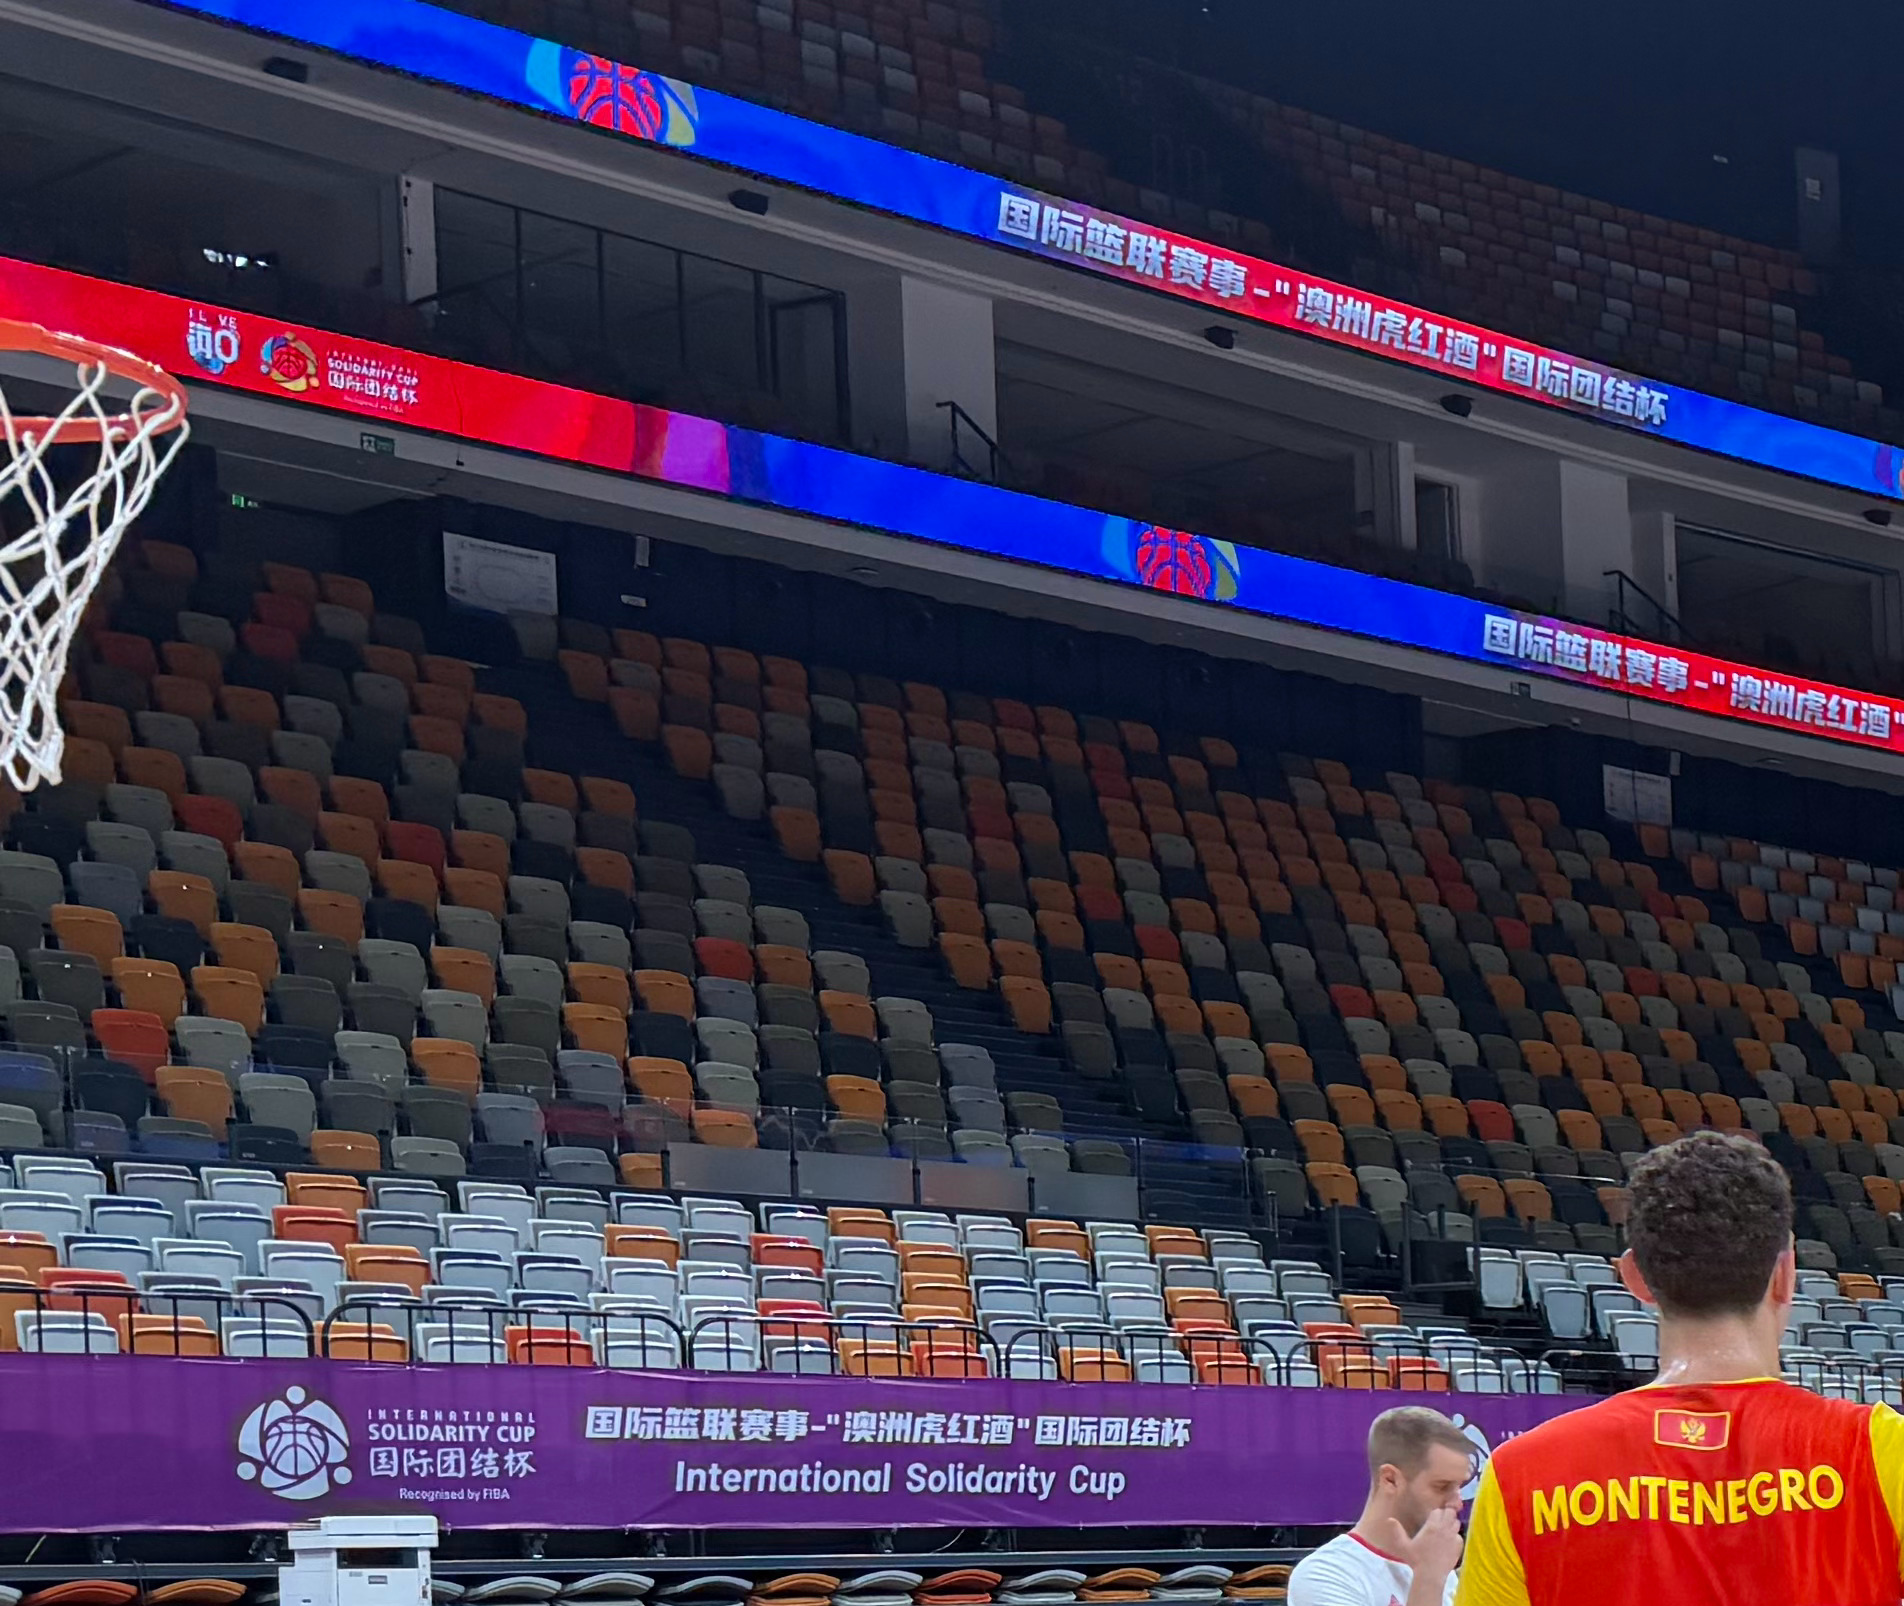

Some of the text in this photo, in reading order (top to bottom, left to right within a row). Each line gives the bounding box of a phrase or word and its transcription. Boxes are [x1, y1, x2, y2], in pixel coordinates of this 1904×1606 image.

[367, 1408, 536, 1424] INTERNATIONAL
[368, 1423, 536, 1443] SOLIDARITY CUP
[369, 1446, 537, 1479] 国际团结杯
[675, 1461, 1126, 1501] International Solidarity Cup
[399, 1487, 511, 1502] Recognised by FIBA
[1532, 1464, 1844, 1536] MONTENEGRO
